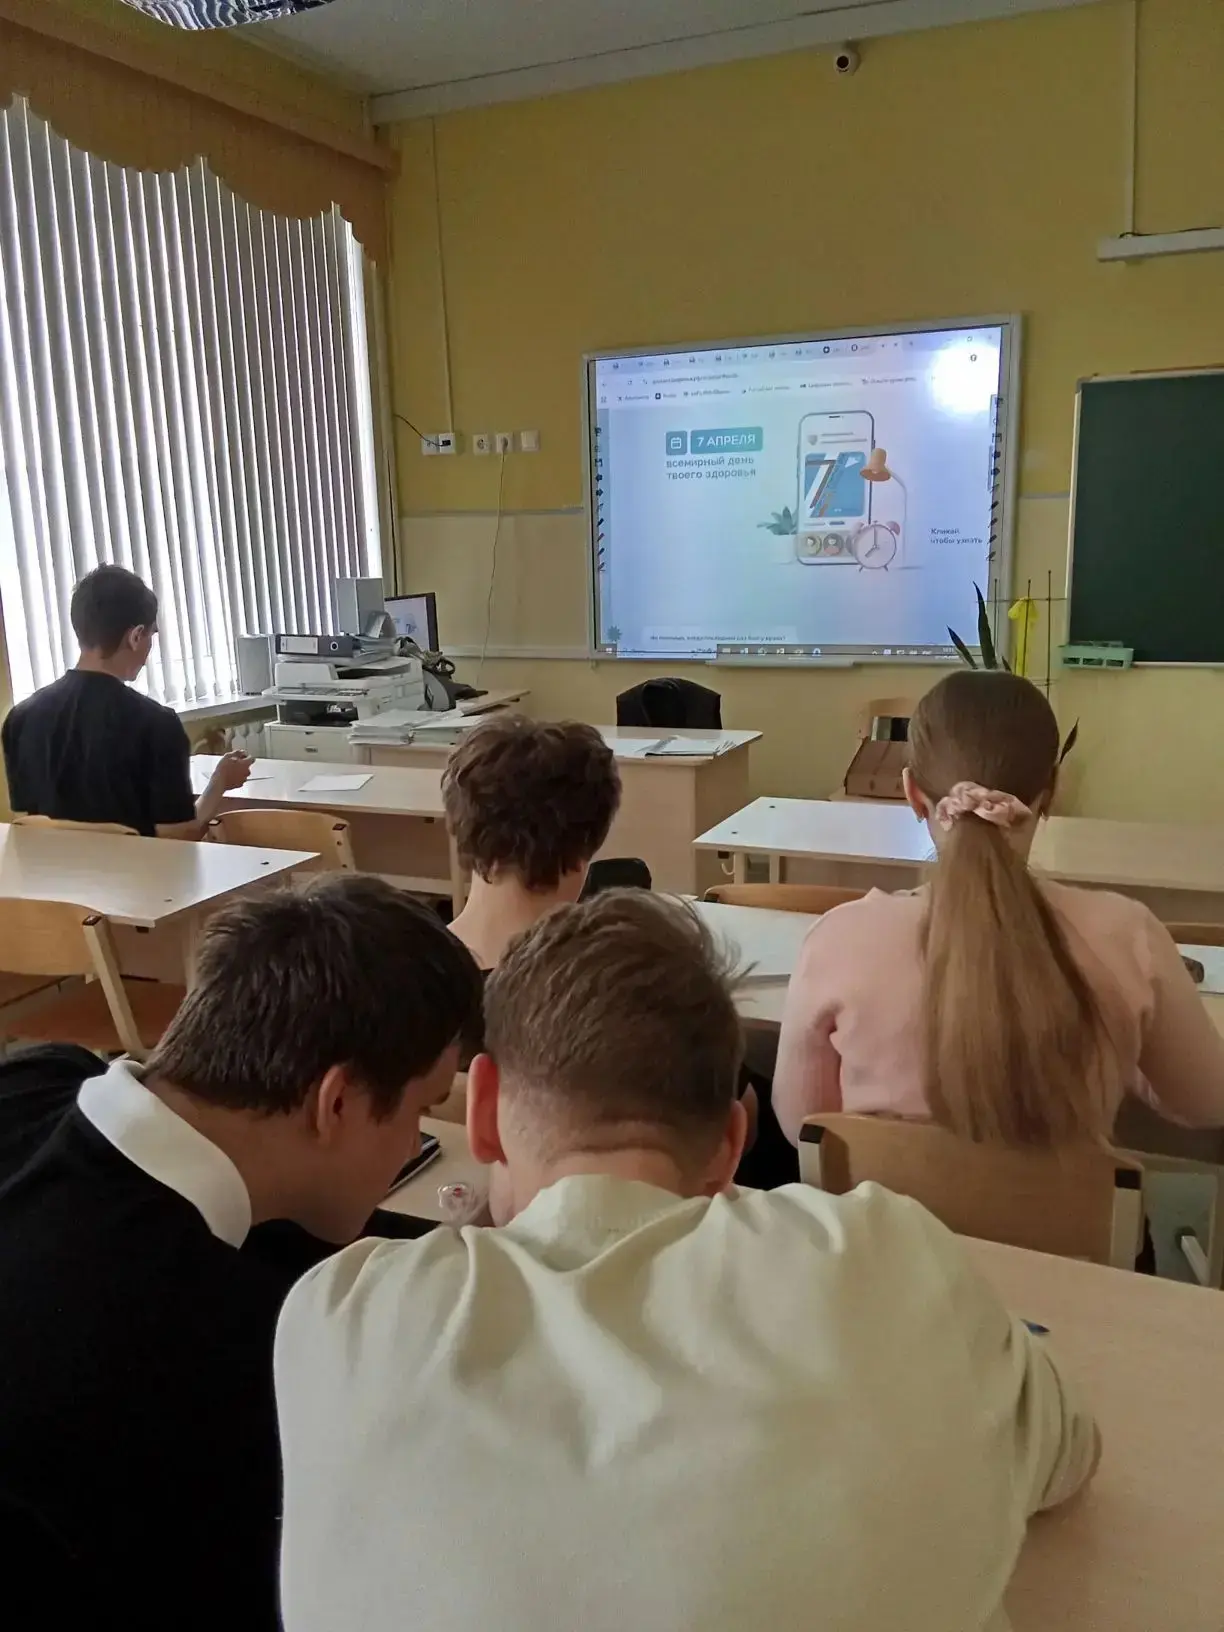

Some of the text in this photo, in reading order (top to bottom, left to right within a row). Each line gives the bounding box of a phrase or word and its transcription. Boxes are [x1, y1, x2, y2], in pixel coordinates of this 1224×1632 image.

[696, 434, 756, 448] 7 АПРЕЛЯ
[666, 456, 754, 469] всемирный день
[666, 468, 756, 480] твоего здоровья
